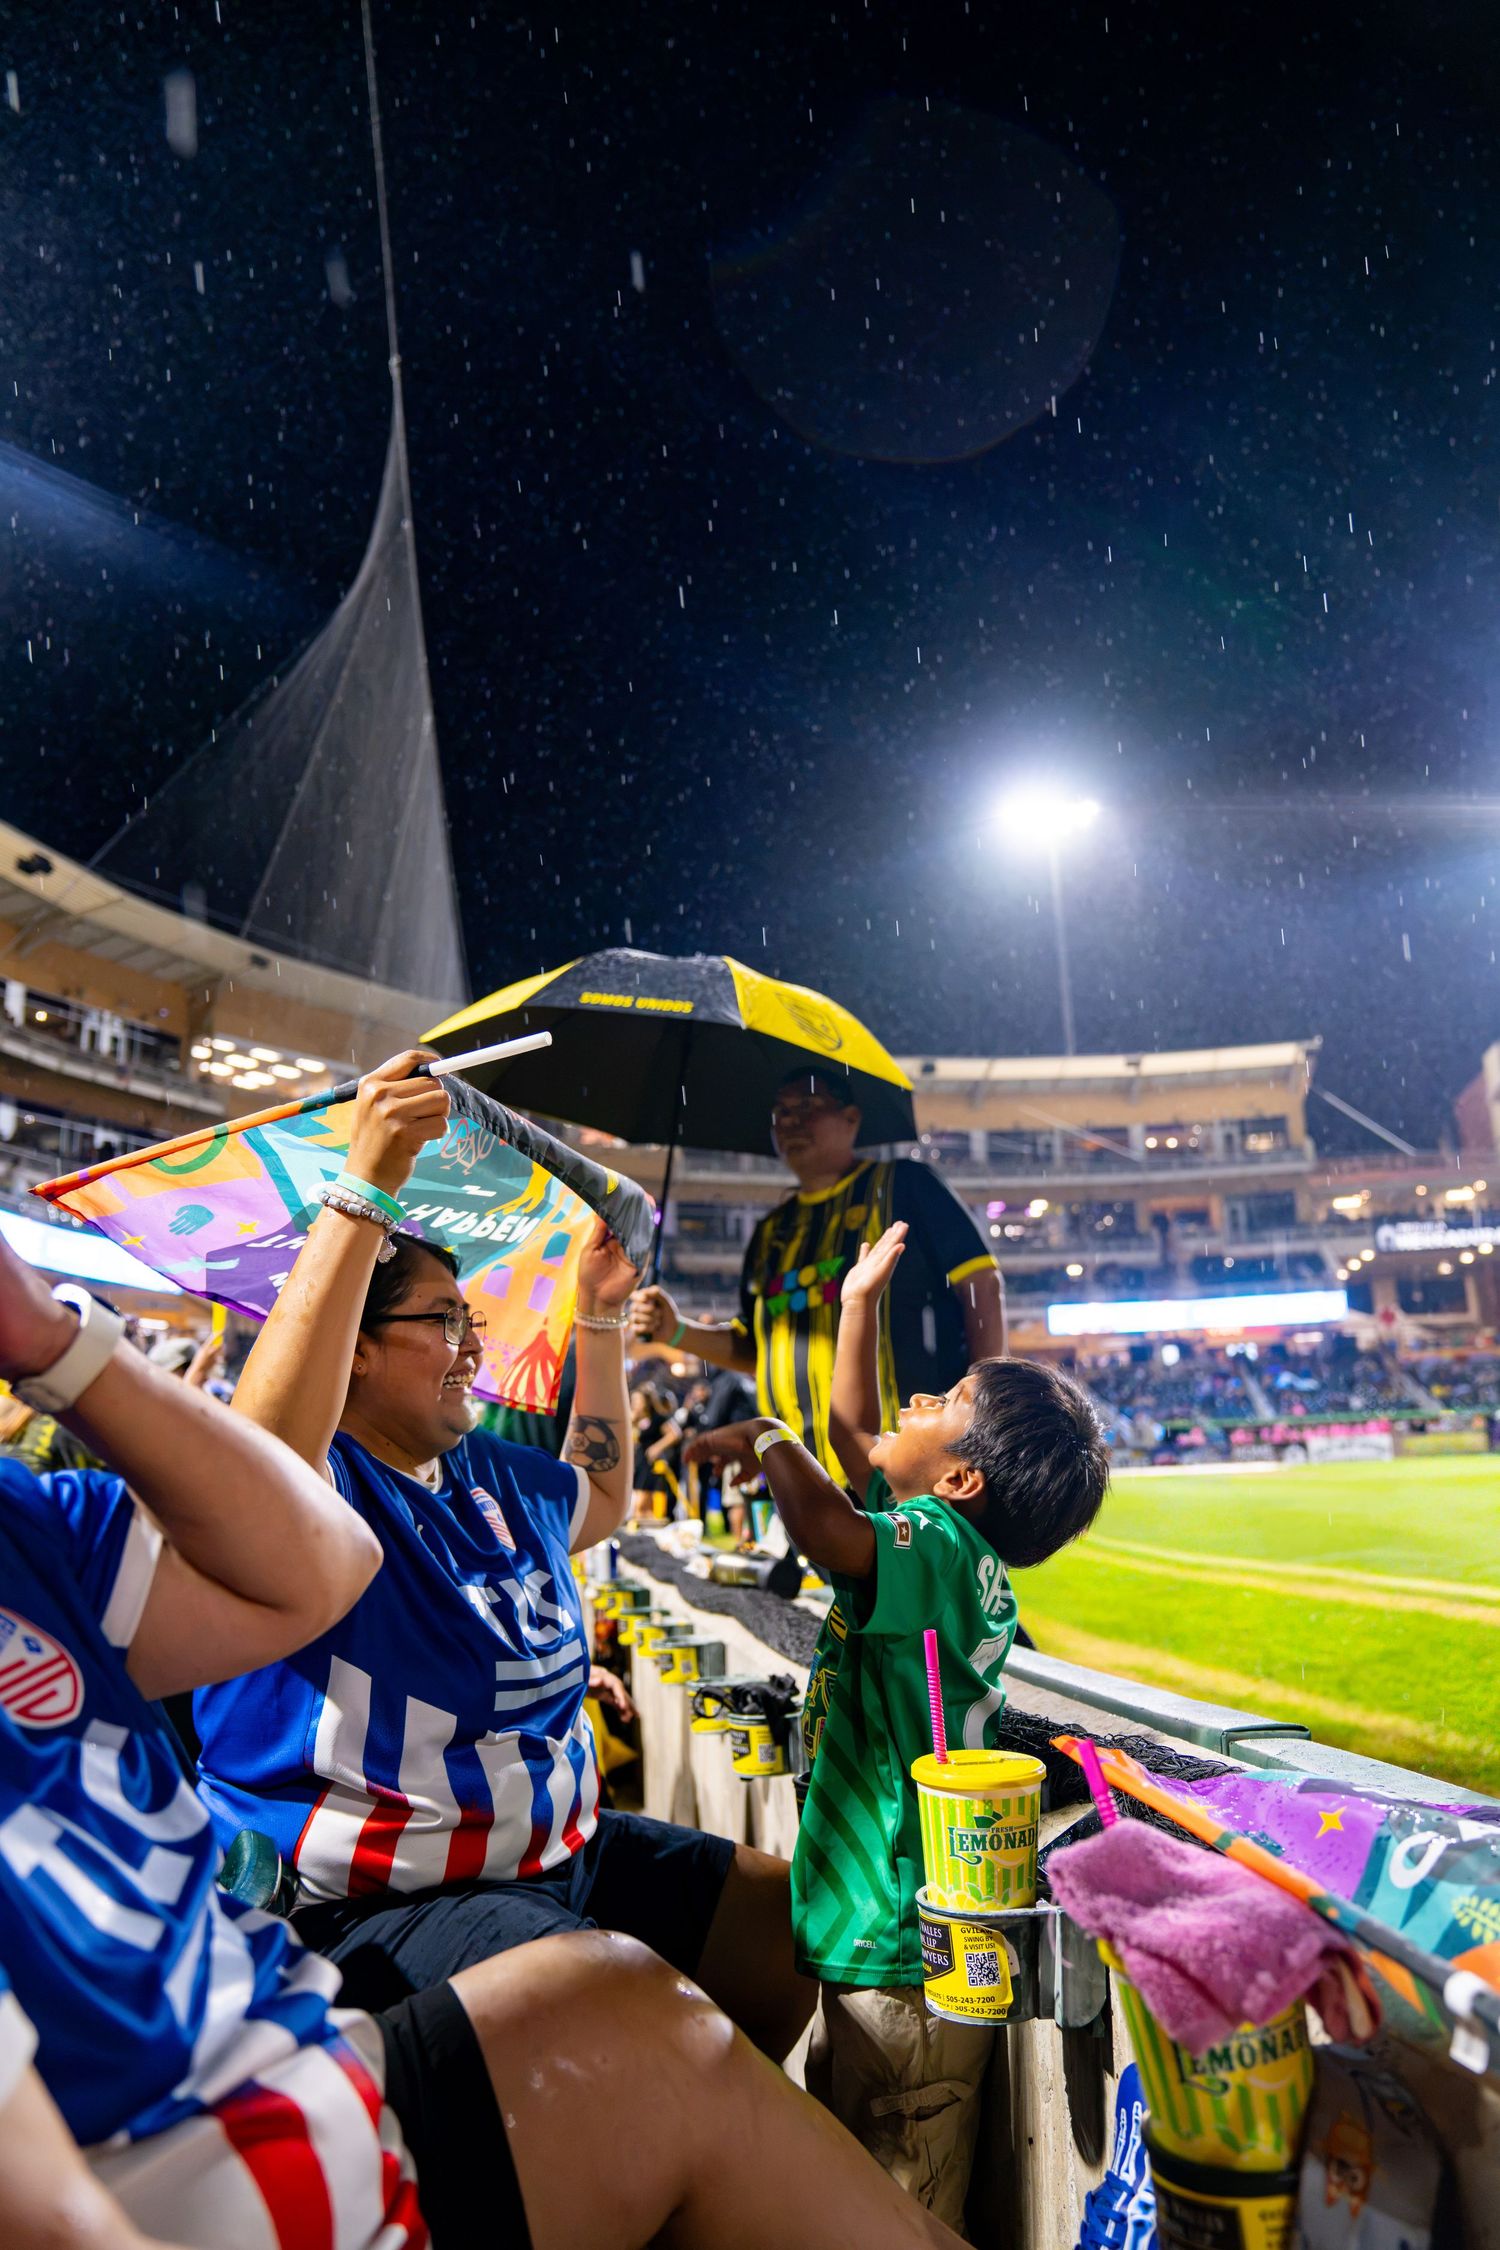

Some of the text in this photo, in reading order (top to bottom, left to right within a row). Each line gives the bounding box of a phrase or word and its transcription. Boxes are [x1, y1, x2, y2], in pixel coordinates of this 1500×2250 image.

[579, 992, 694, 1014] SOMOS UNIDOS
[948, 1820, 1039, 1865] LEMONAD
[946, 1994, 996, 2004] 505-243-7200
